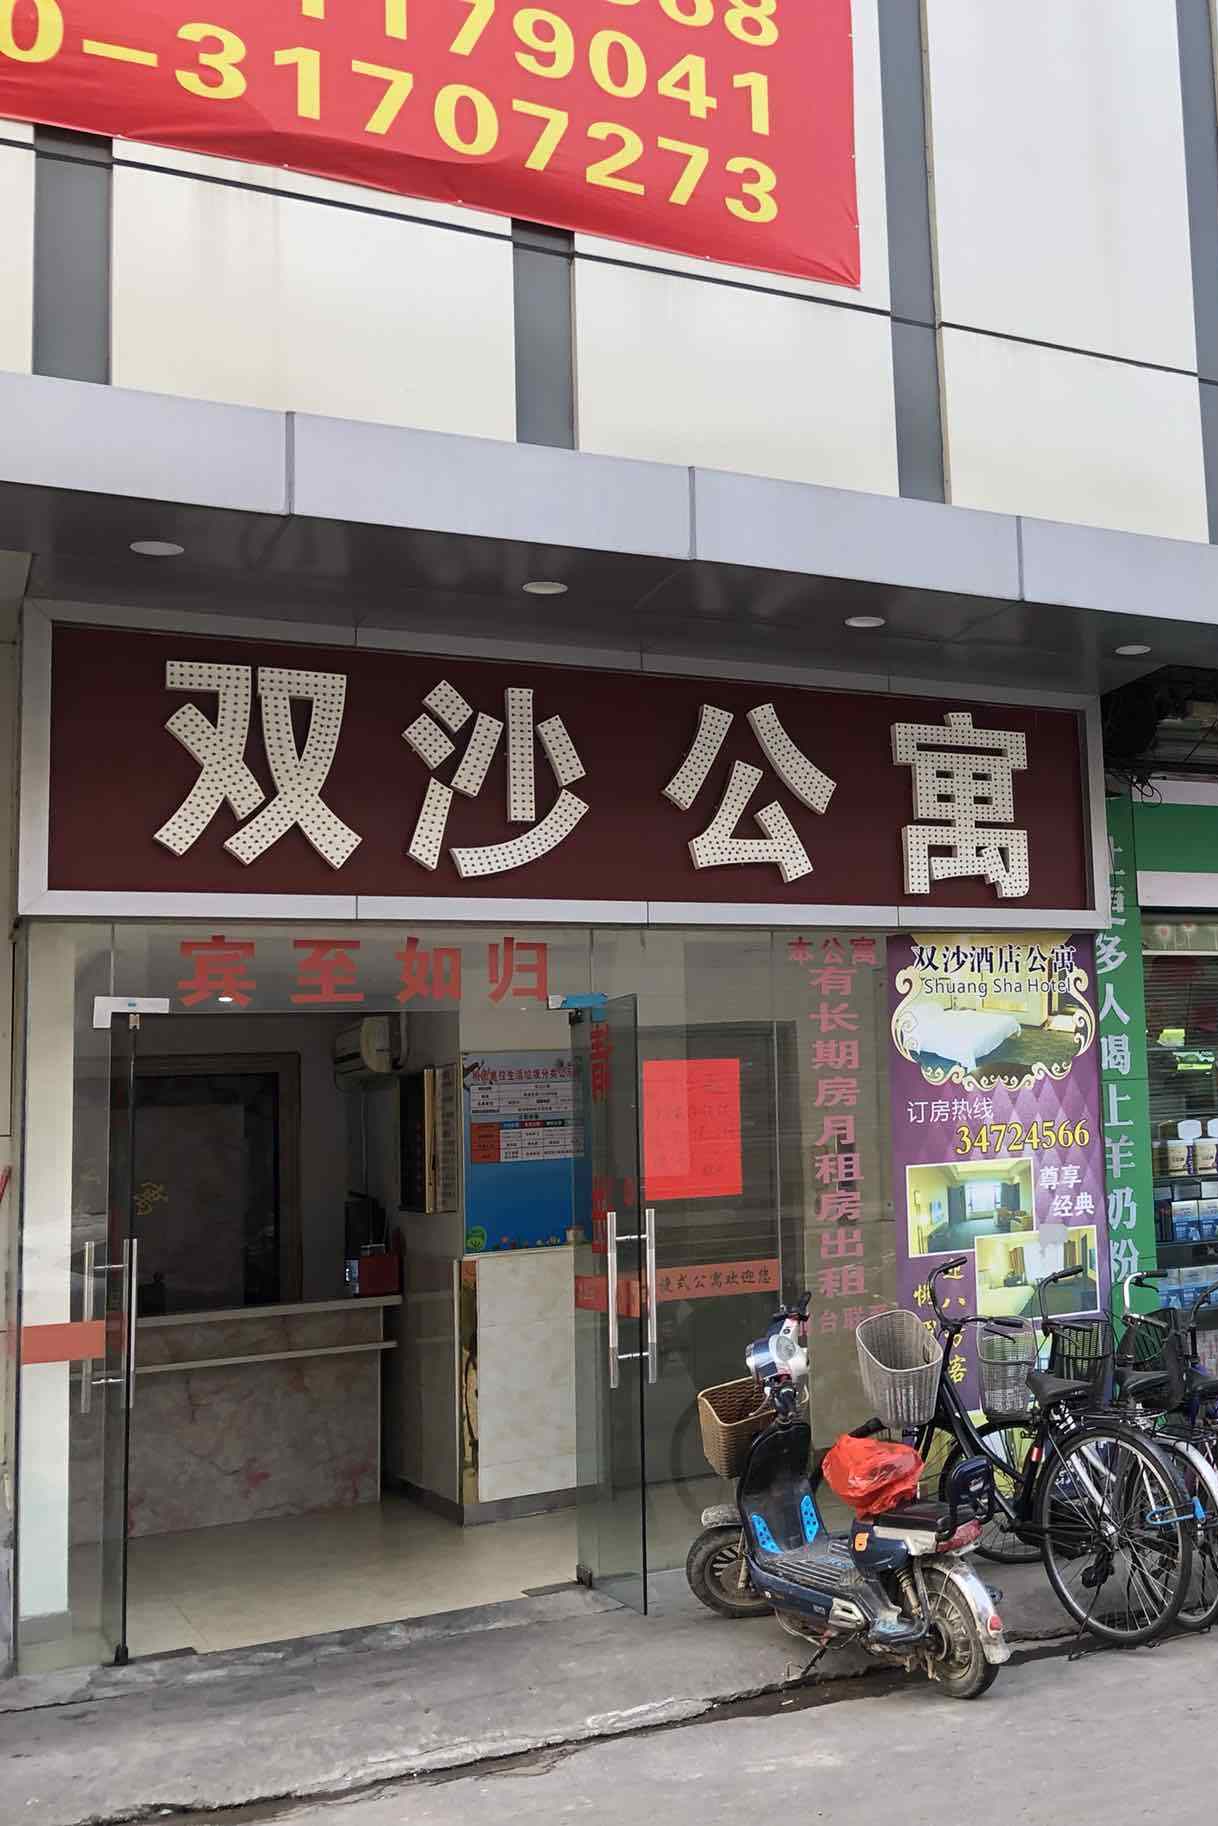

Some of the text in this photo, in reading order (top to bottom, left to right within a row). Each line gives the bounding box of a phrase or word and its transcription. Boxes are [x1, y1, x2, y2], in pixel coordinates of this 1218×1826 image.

[301, 0, 769, 136] 179041
[153, 660, 1029, 900] 双沙公寓
[177, 935, 549, 1007] 宾至如归
[911, 943, 1078, 974] 双沙酒店公寓
[924, 976, 1071, 997] Shuang Sha Hotel
[907, 1096, 994, 1124] 订房热线
[808, 967, 866, 1299] 有长期房月租房出租
[955, 1119, 1091, 1154] 34724566
[1039, 1164, 1082, 1190] 尊享
[1051, 1191, 1095, 1217] 经典
